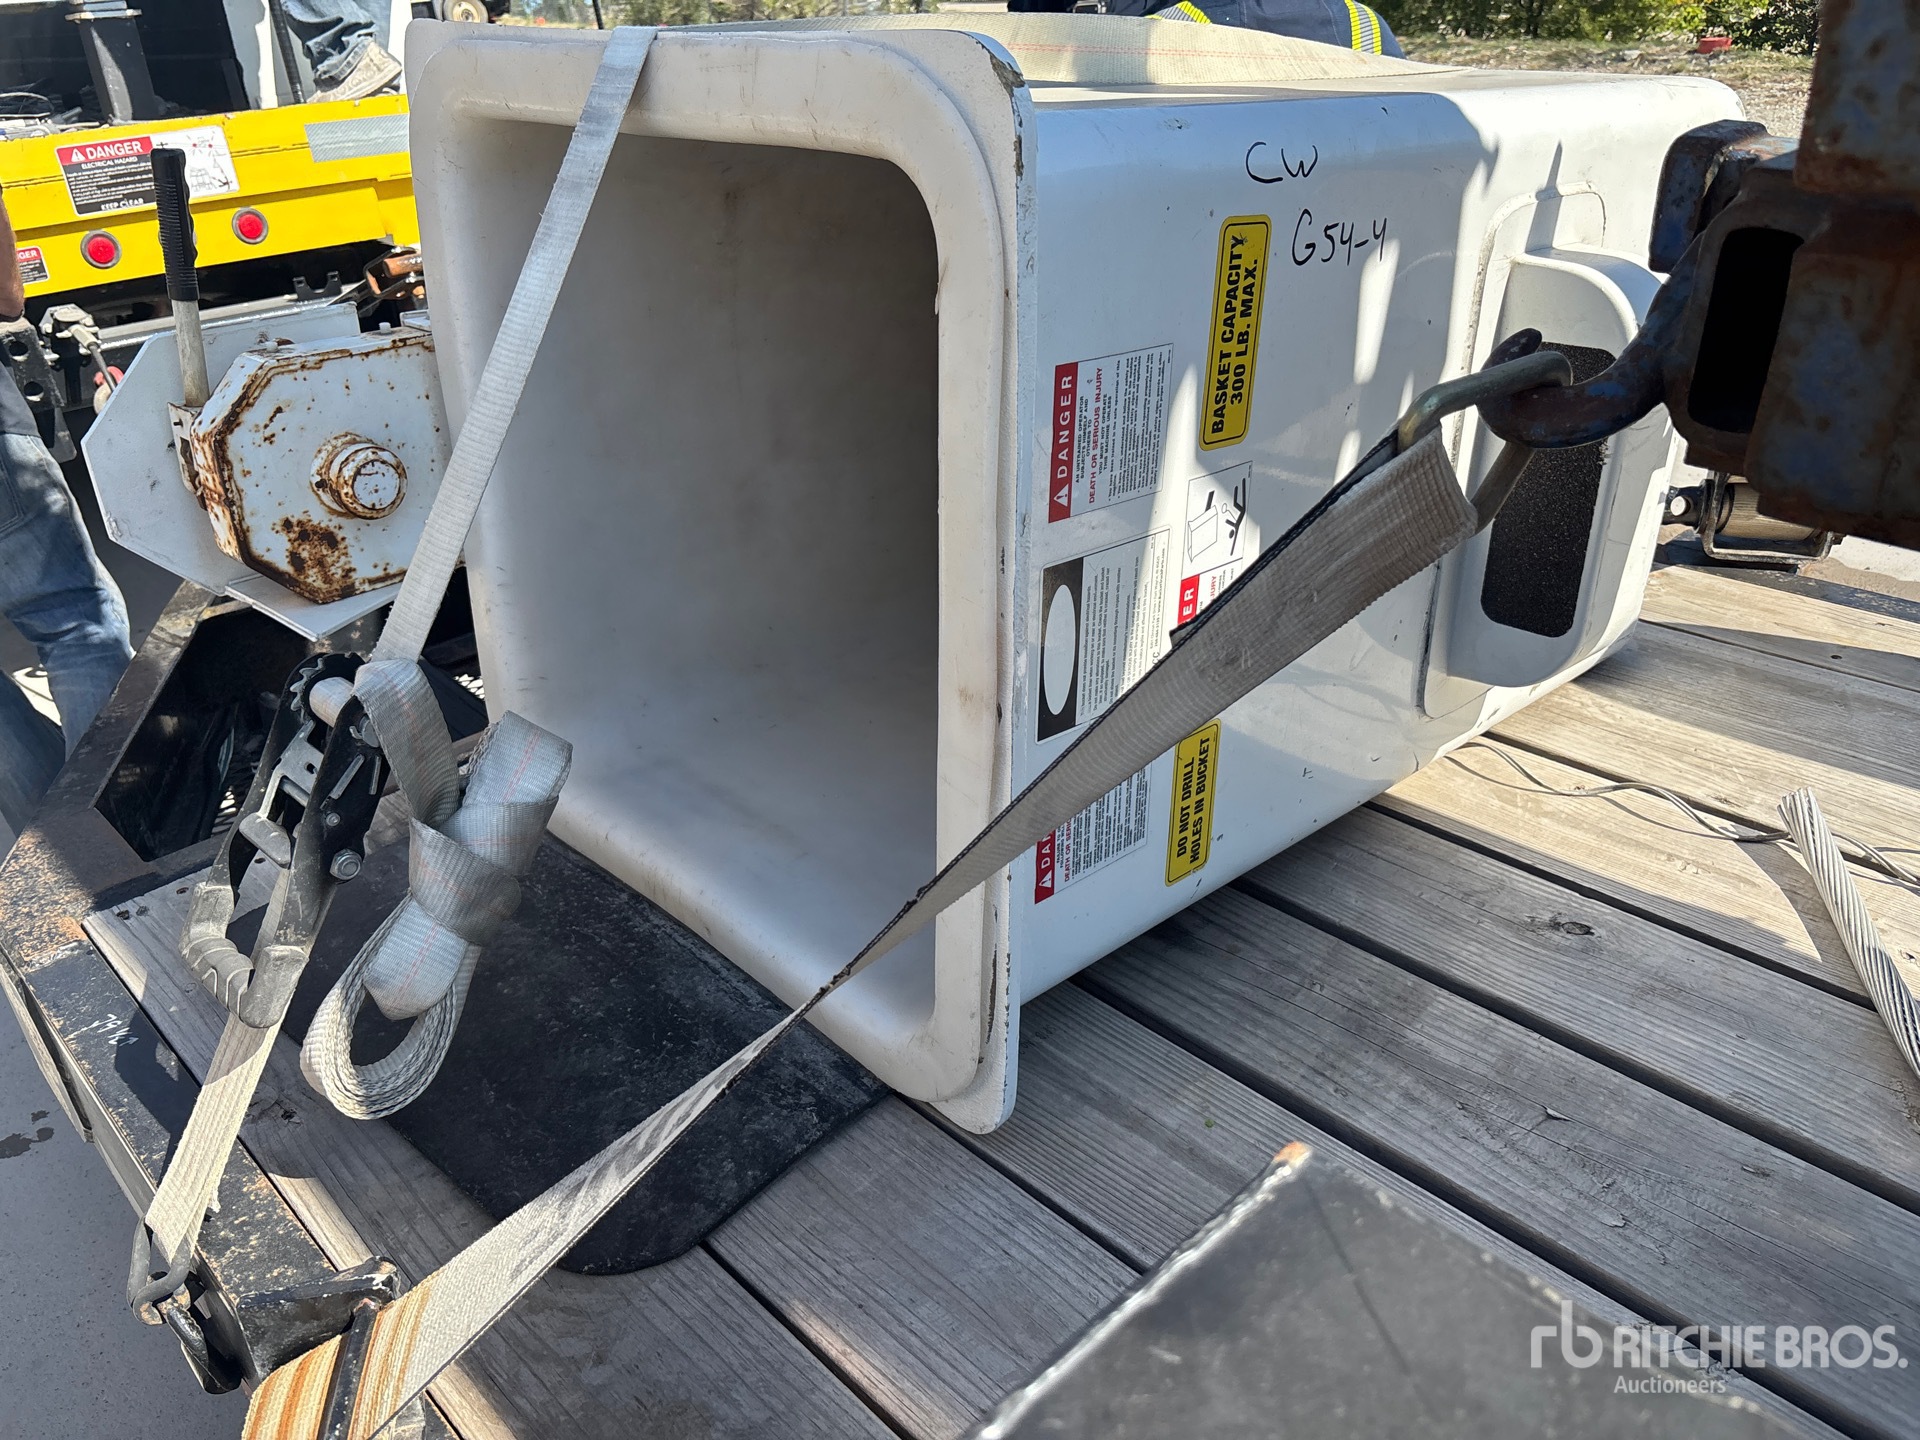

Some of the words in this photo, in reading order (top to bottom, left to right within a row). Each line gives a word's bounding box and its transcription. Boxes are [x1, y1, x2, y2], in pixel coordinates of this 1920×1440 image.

[81, 159, 114, 169] ELECTRICAL
[115, 156, 138, 165] HAZARD
[86, 140, 143, 160] DANGER
[1245, 141, 1318, 184] CW
[101, 201, 119, 210] KEEP
[119, 198, 144, 208] CLEAR
[1291, 208, 1388, 267] G54-4
[1221, 236, 1244, 343] CAPACITY
[1240, 260, 1257, 318] MAX.
[1235, 324, 1251, 357] LB.
[1212, 351, 1231, 433] BASKET
[1230, 364, 1246, 405] 300
[1057, 376, 1072, 478] DANGER
[1087, 419, 1092, 428] TO
[1092, 406, 1100, 450] SERIOUS
[1075, 474, 1080, 483] AN
[1091, 454, 1097, 469] OR
[1181, 757, 1194, 801] DRILL
[1195, 738, 1209, 795] BUCKET
[1179, 805, 1190, 834] NOT
[1194, 798, 1204, 815] IN
[1065, 843, 1071, 855] OR
[1177, 836, 1188, 858] DO
[1190, 817, 1203, 864] HOLES
